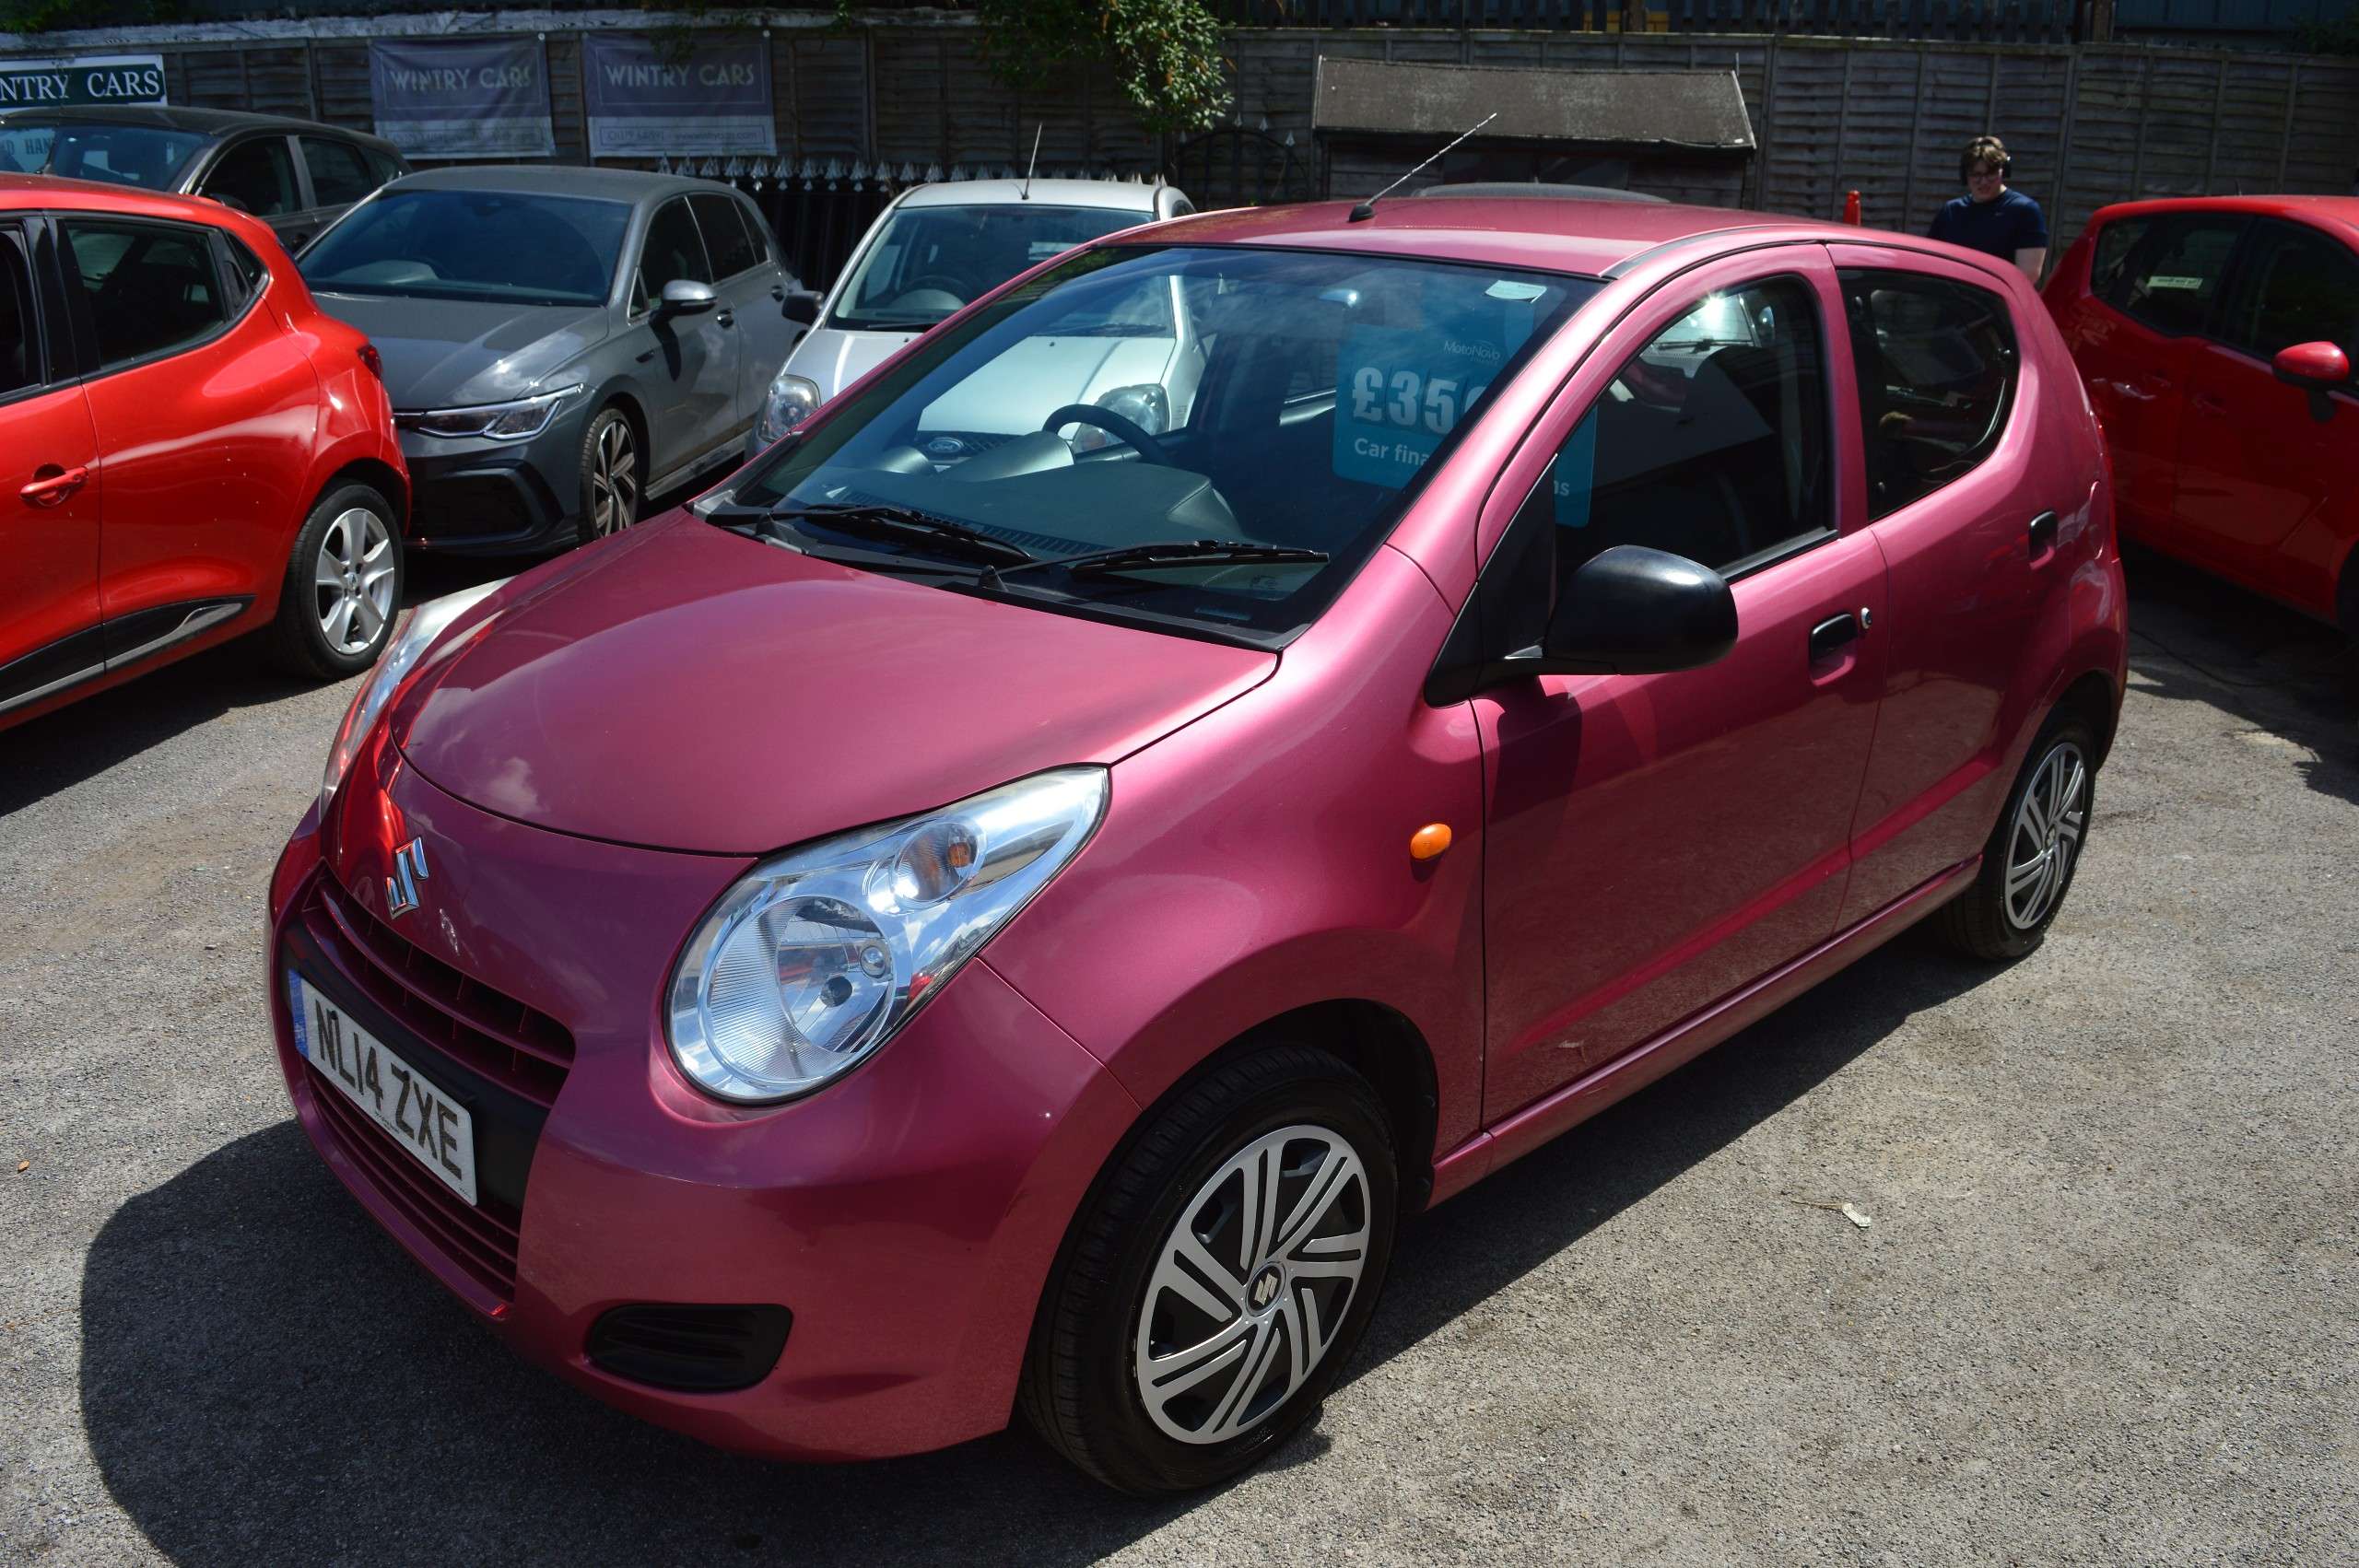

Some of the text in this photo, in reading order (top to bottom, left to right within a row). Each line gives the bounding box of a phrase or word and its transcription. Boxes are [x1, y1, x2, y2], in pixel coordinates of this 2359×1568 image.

[88, 70, 160, 98] CARS
[390, 65, 532, 90] WINTRY CARS
[604, 64, 755, 87] WINTRY CARS
[1354, 438, 1390, 459] Car
[315, 999, 463, 1182] NL14 ZXE
